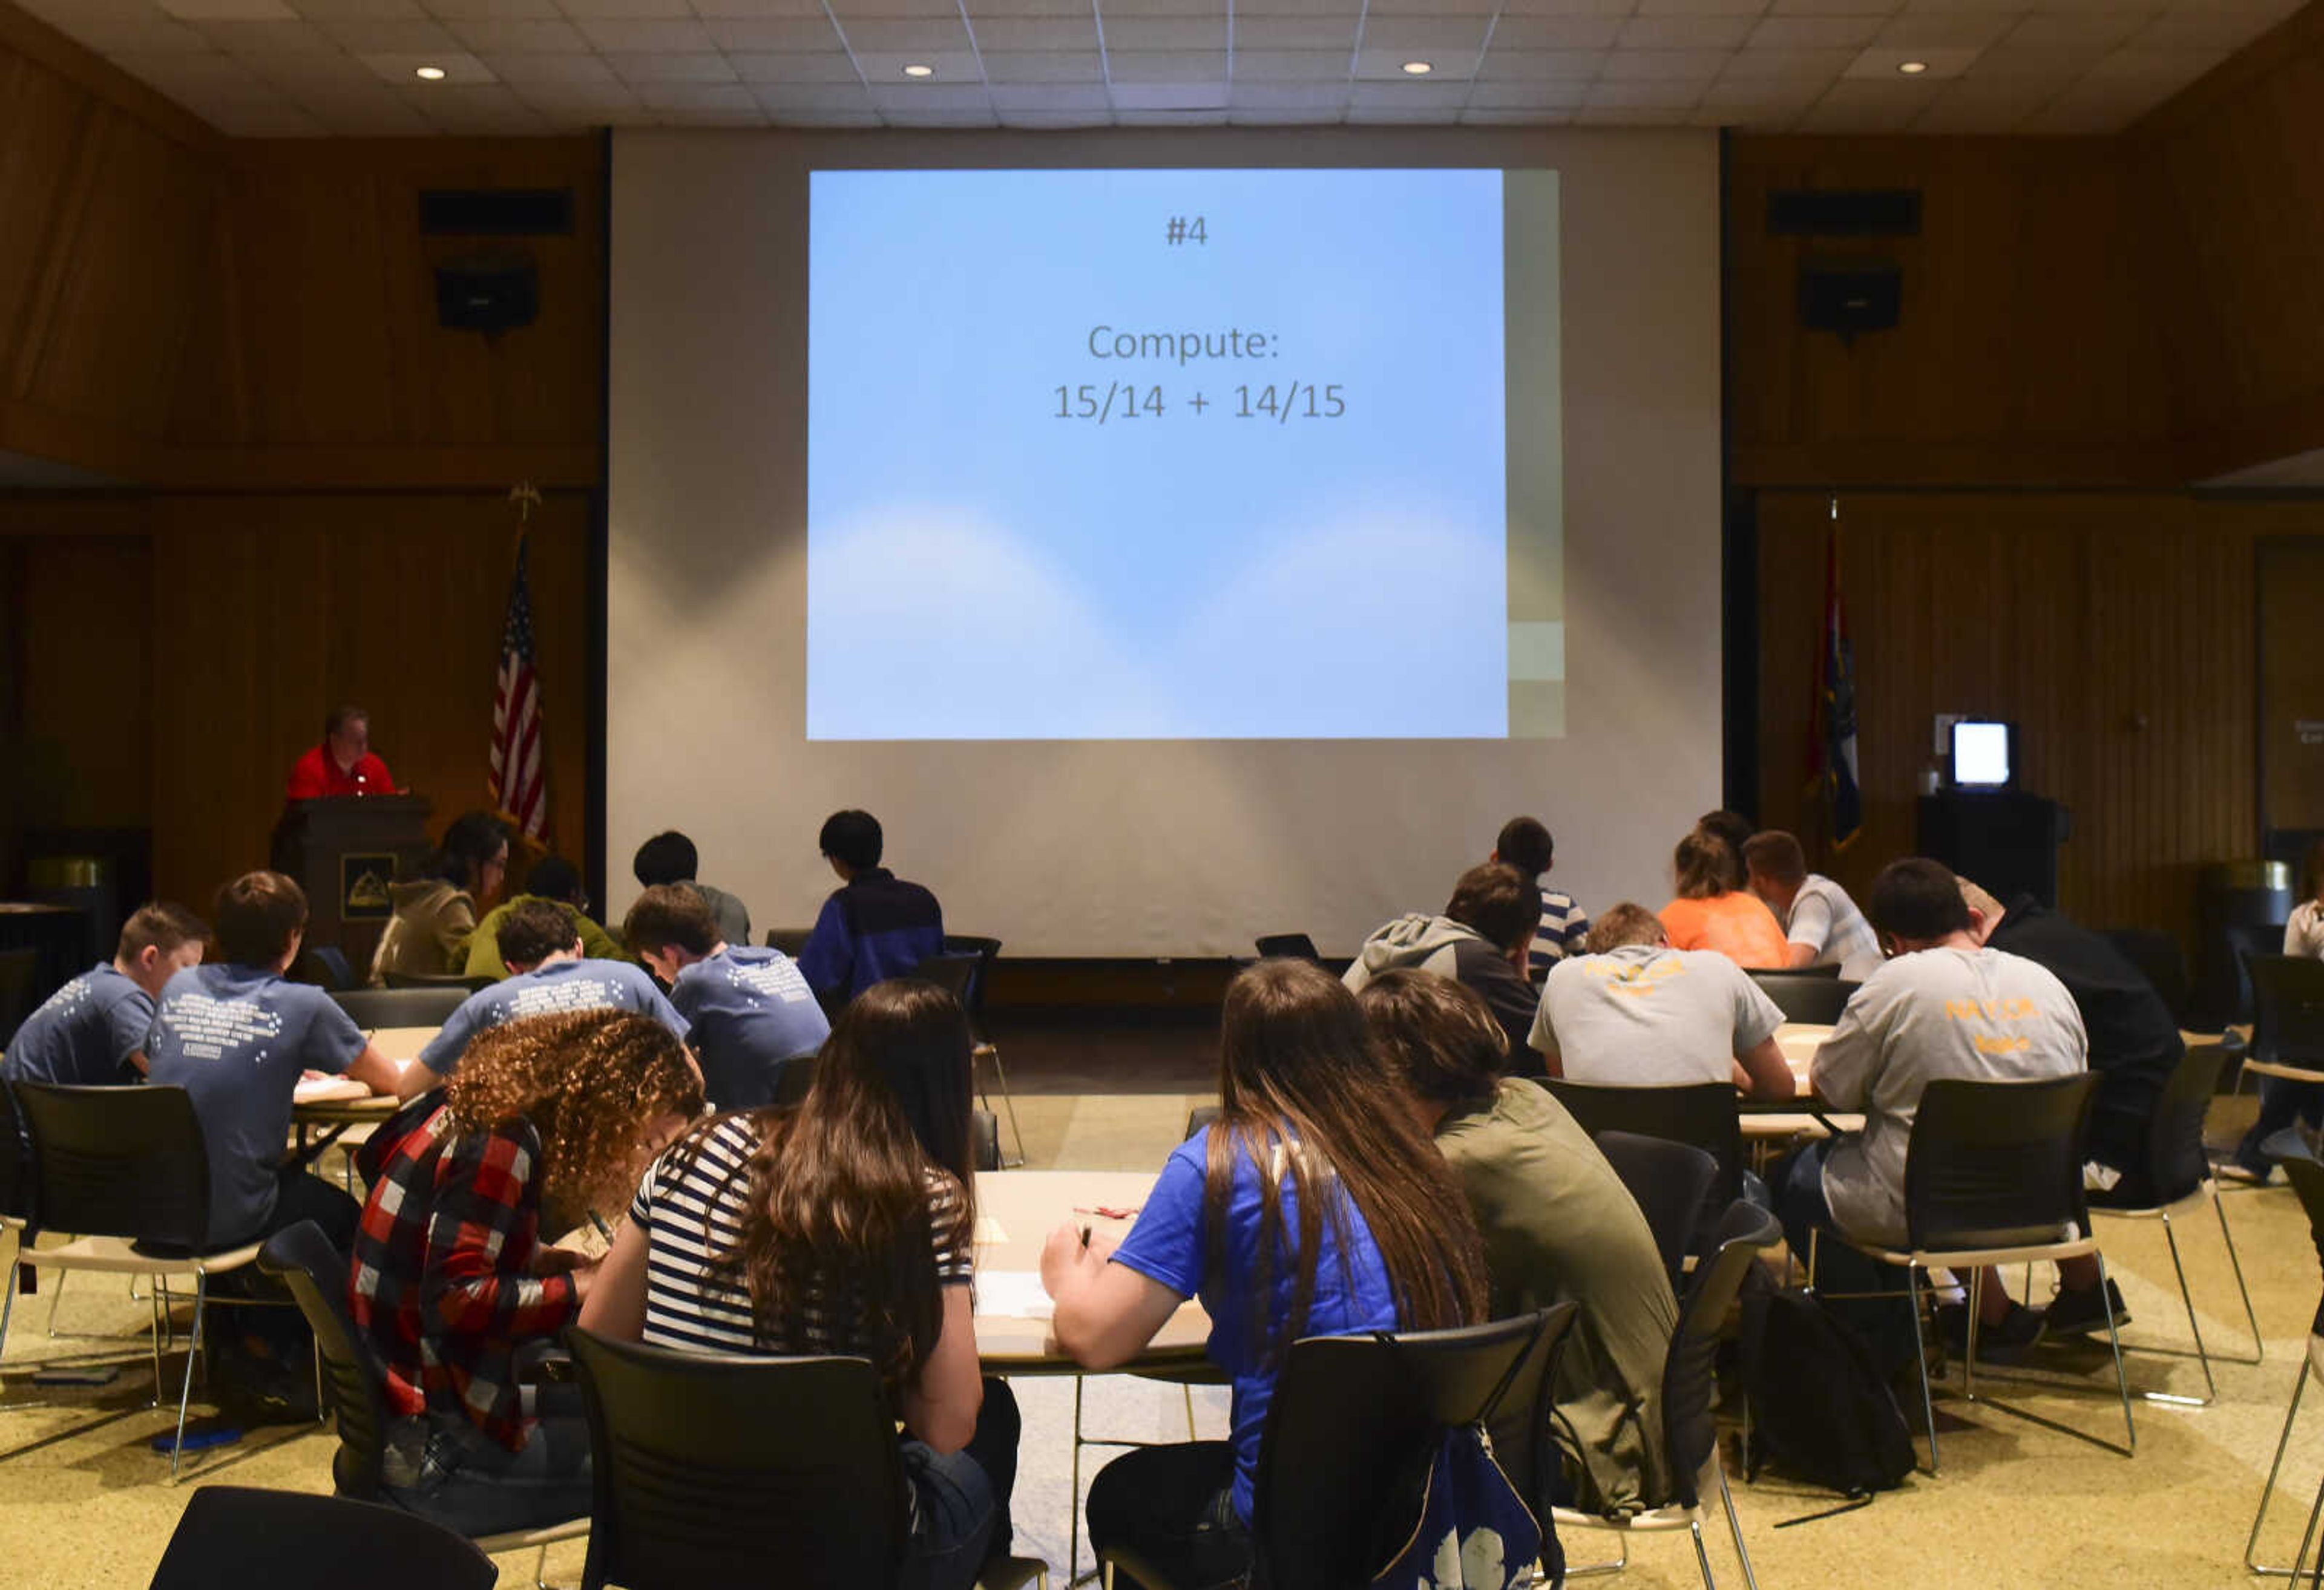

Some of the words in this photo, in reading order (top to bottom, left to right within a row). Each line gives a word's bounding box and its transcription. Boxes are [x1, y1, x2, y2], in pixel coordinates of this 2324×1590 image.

[1166, 216, 1209, 244] #4
[1089, 324, 1279, 366] Compute:
[1054, 381, 1166, 424] 15/14
[1187, 392, 1210, 415] +
[1234, 381, 1345, 424] 14/15
